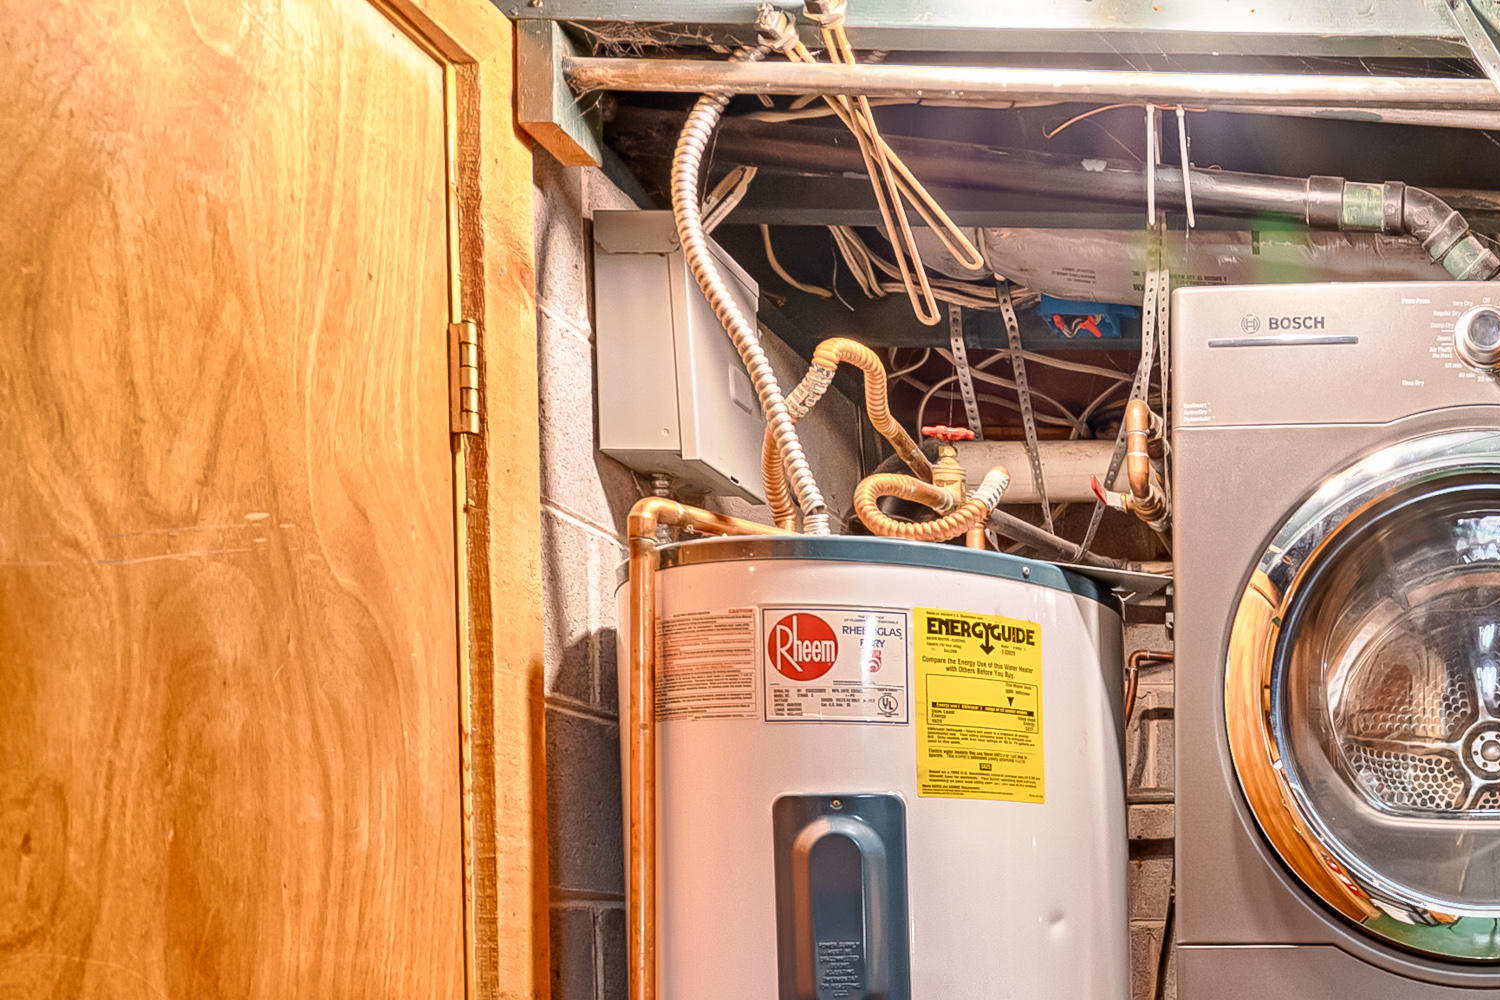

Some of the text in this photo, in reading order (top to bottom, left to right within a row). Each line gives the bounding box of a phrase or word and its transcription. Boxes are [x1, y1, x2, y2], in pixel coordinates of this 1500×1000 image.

[1269, 316, 1325, 330] BOSCH
[776, 616, 835, 672] Rheem
[860, 640, 885, 648] FRY
[922, 656, 946, 664] Compare
[958, 658, 975, 667] Energy
[1004, 663, 1017, 671] Water
[1019, 665, 1033, 674] Heater
[959, 666, 975, 674] Others
[977, 668, 992, 676] Before
